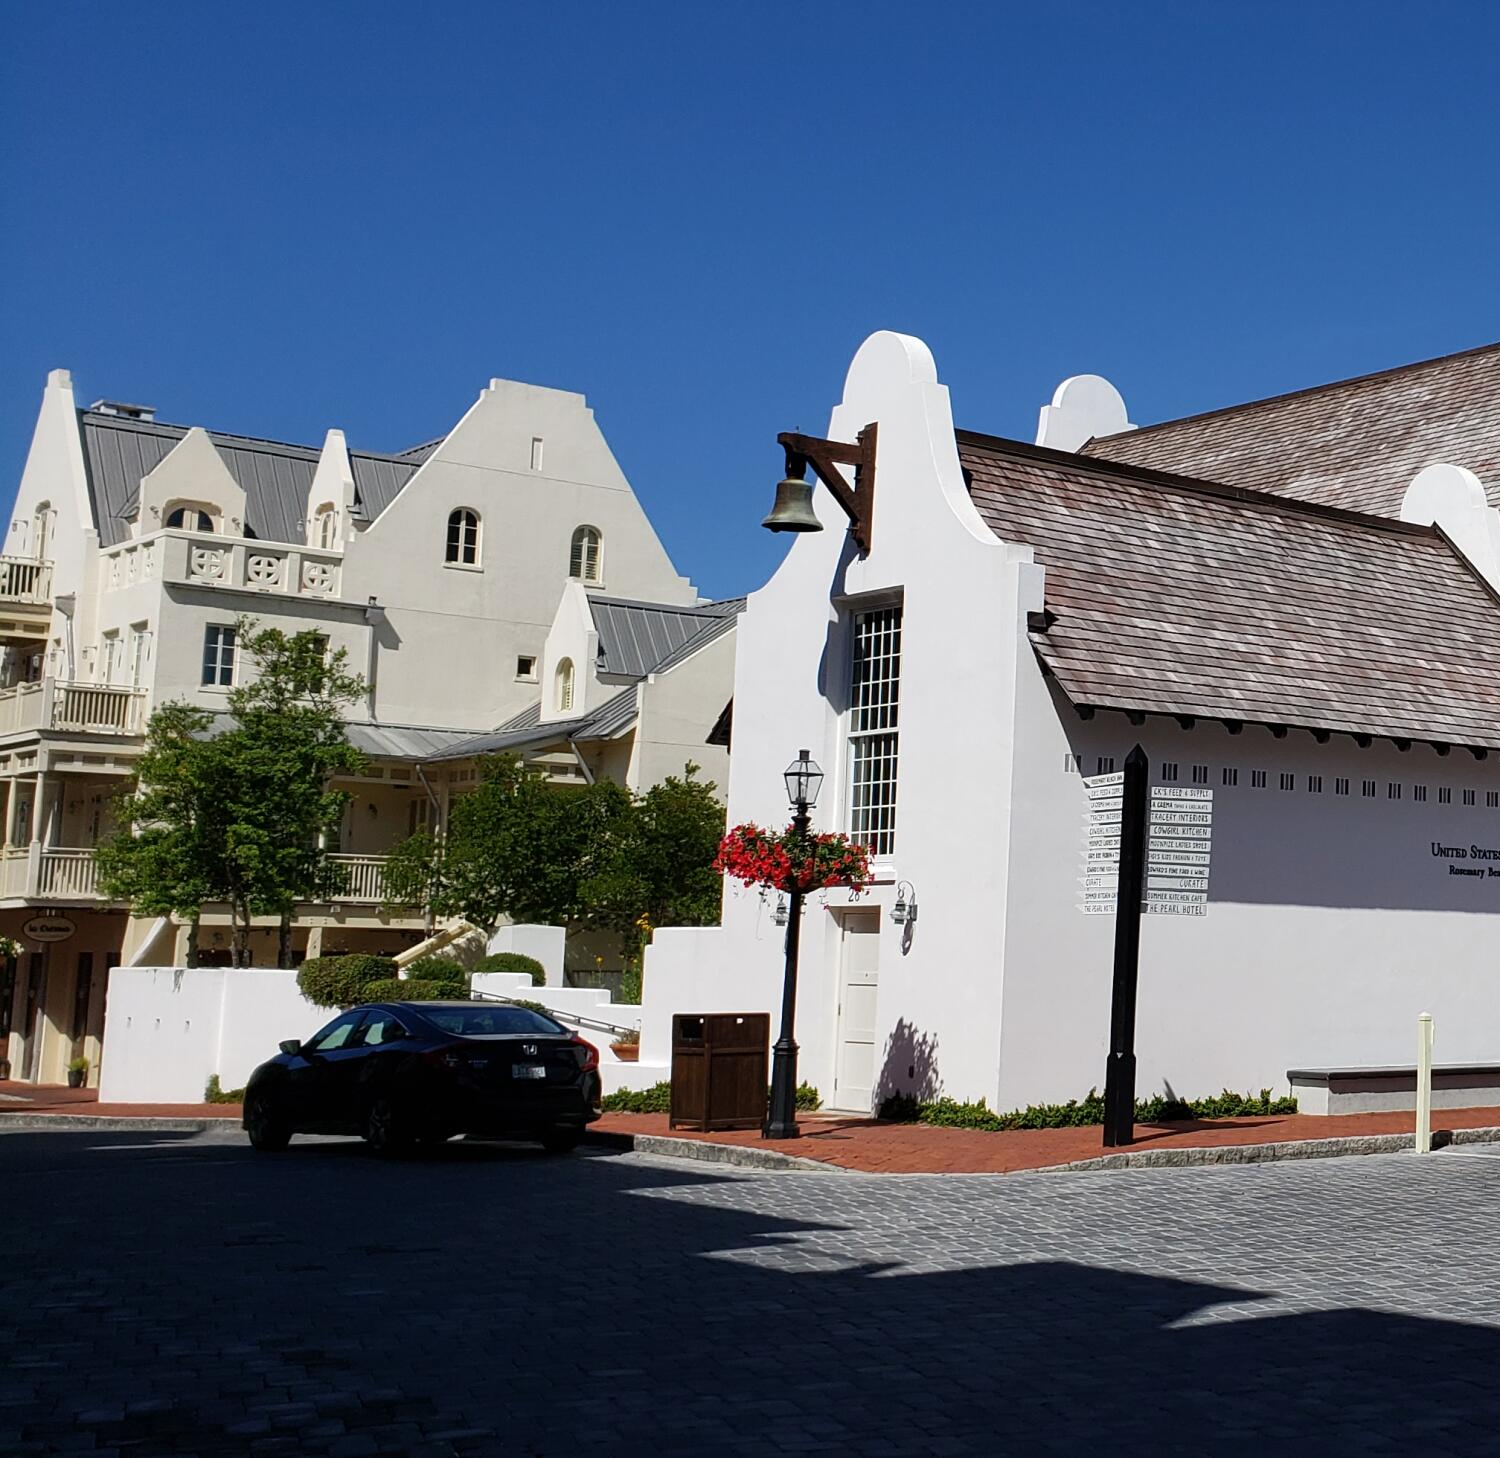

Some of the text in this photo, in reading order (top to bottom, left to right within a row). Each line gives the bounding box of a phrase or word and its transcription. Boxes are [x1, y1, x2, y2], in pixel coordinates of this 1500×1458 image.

[1153, 787, 1168, 796] CK'S
[1169, 788, 1182, 797] FEED
[1190, 789, 1209, 798] SUPPLY
[1151, 812, 1208, 823] TRACERY INTERIORS
[1153, 826, 1208, 836] COWGIRL KITCHEN
[1431, 842, 1467, 858] UNITED
[1449, 864, 1485, 879] Rosemary
[1179, 879, 1205, 888] CURATE
[1147, 892, 1203, 903] SUMMER KITCHEN CAFE
[1161, 904, 1180, 913] PEARL
[1182, 905, 1204, 915] HOTEL
